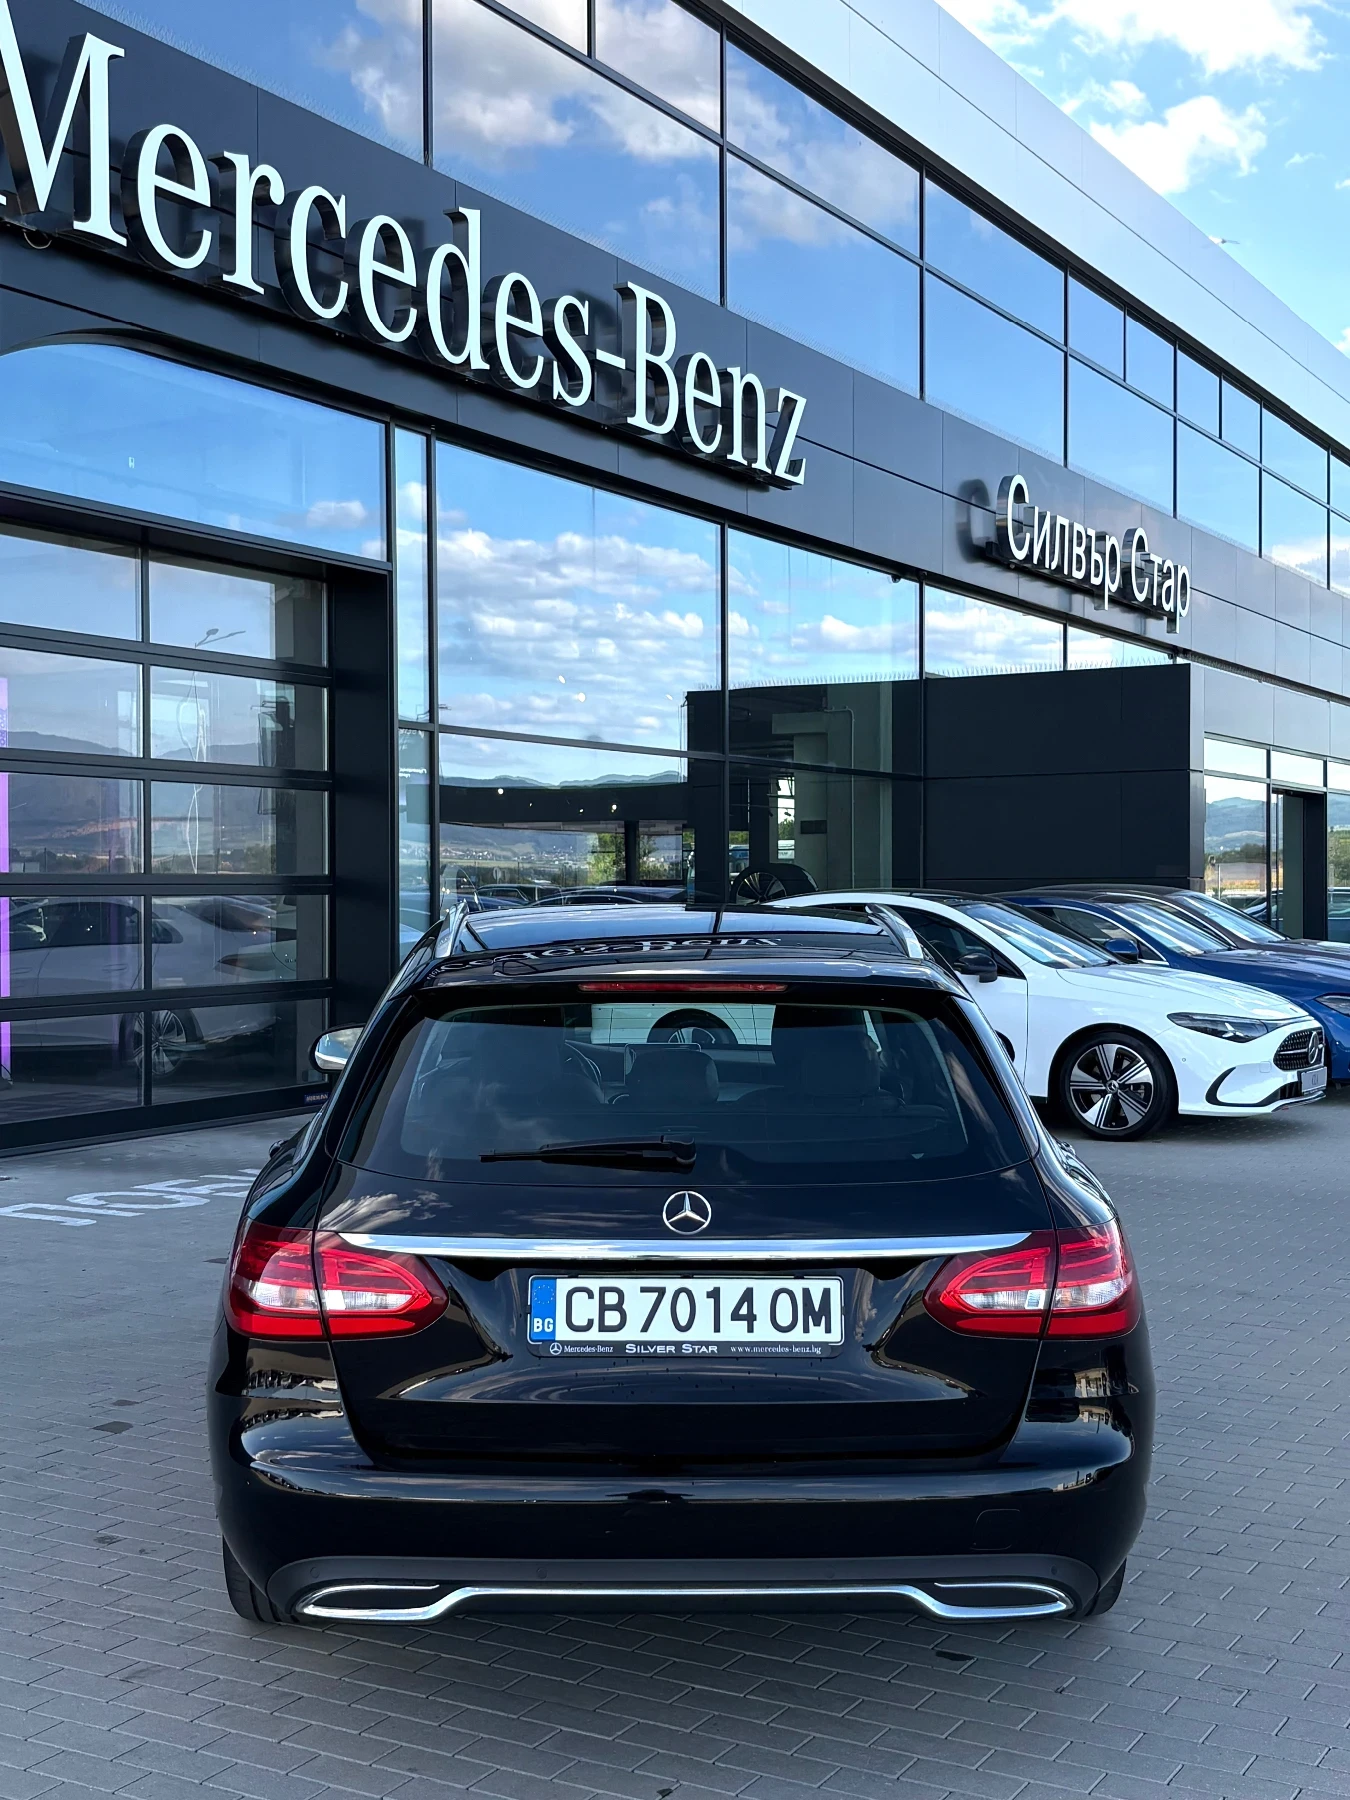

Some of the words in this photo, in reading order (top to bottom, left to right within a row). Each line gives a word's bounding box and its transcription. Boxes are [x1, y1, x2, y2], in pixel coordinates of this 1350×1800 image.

[0, 0, 807, 485] Mercedes-Benz
[1007, 474, 1121, 610] Силвър
[1131, 527, 1190, 634] Стар
[533, 1317, 554, 1333] BG
[565, 1286, 628, 1333] CB
[640, 1286, 758, 1334] 7014
[769, 1287, 832, 1334] OM
[563, 1345, 614, 1354] Mercedes-Benz
[625, 1343, 676, 1354] SILVER
[682, 1343, 718, 1354] STAR
[730, 1344, 822, 1355] www.mercedes-benz.bg
